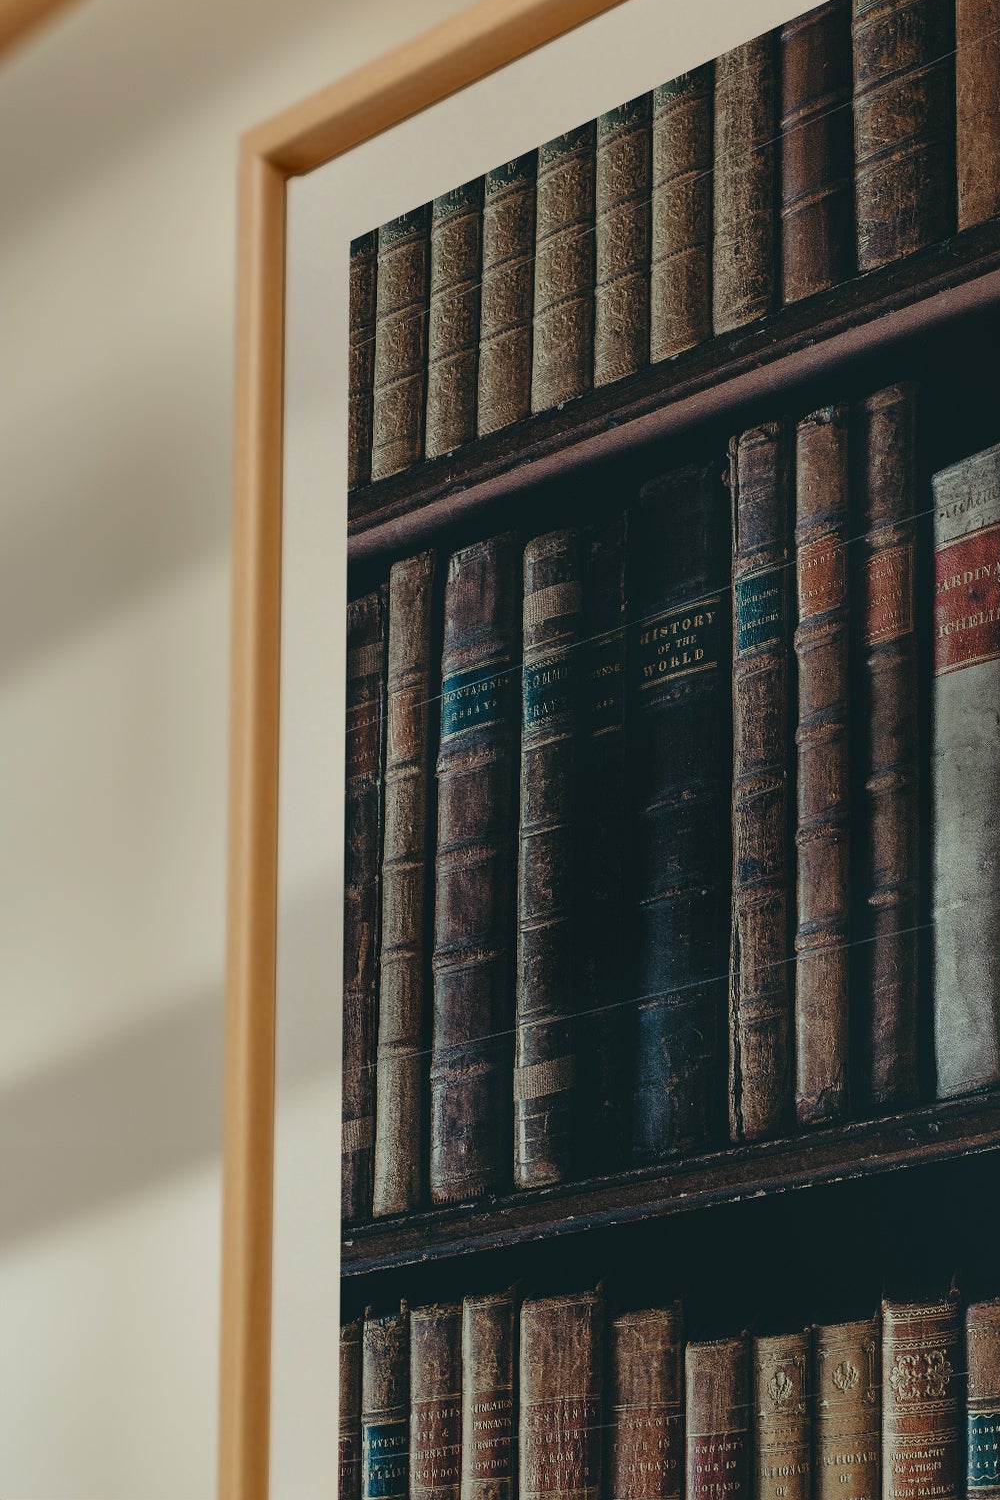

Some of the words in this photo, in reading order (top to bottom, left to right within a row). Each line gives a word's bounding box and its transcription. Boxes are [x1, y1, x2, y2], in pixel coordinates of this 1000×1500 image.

[640, 611, 716, 646] HISTORY
[657, 642, 671, 655] OF
[675, 634, 697, 648] THE
[643, 648, 704, 676] WORLD
[894, 1464, 906, 1475] OF
[909, 1461, 942, 1473] ATHENS
